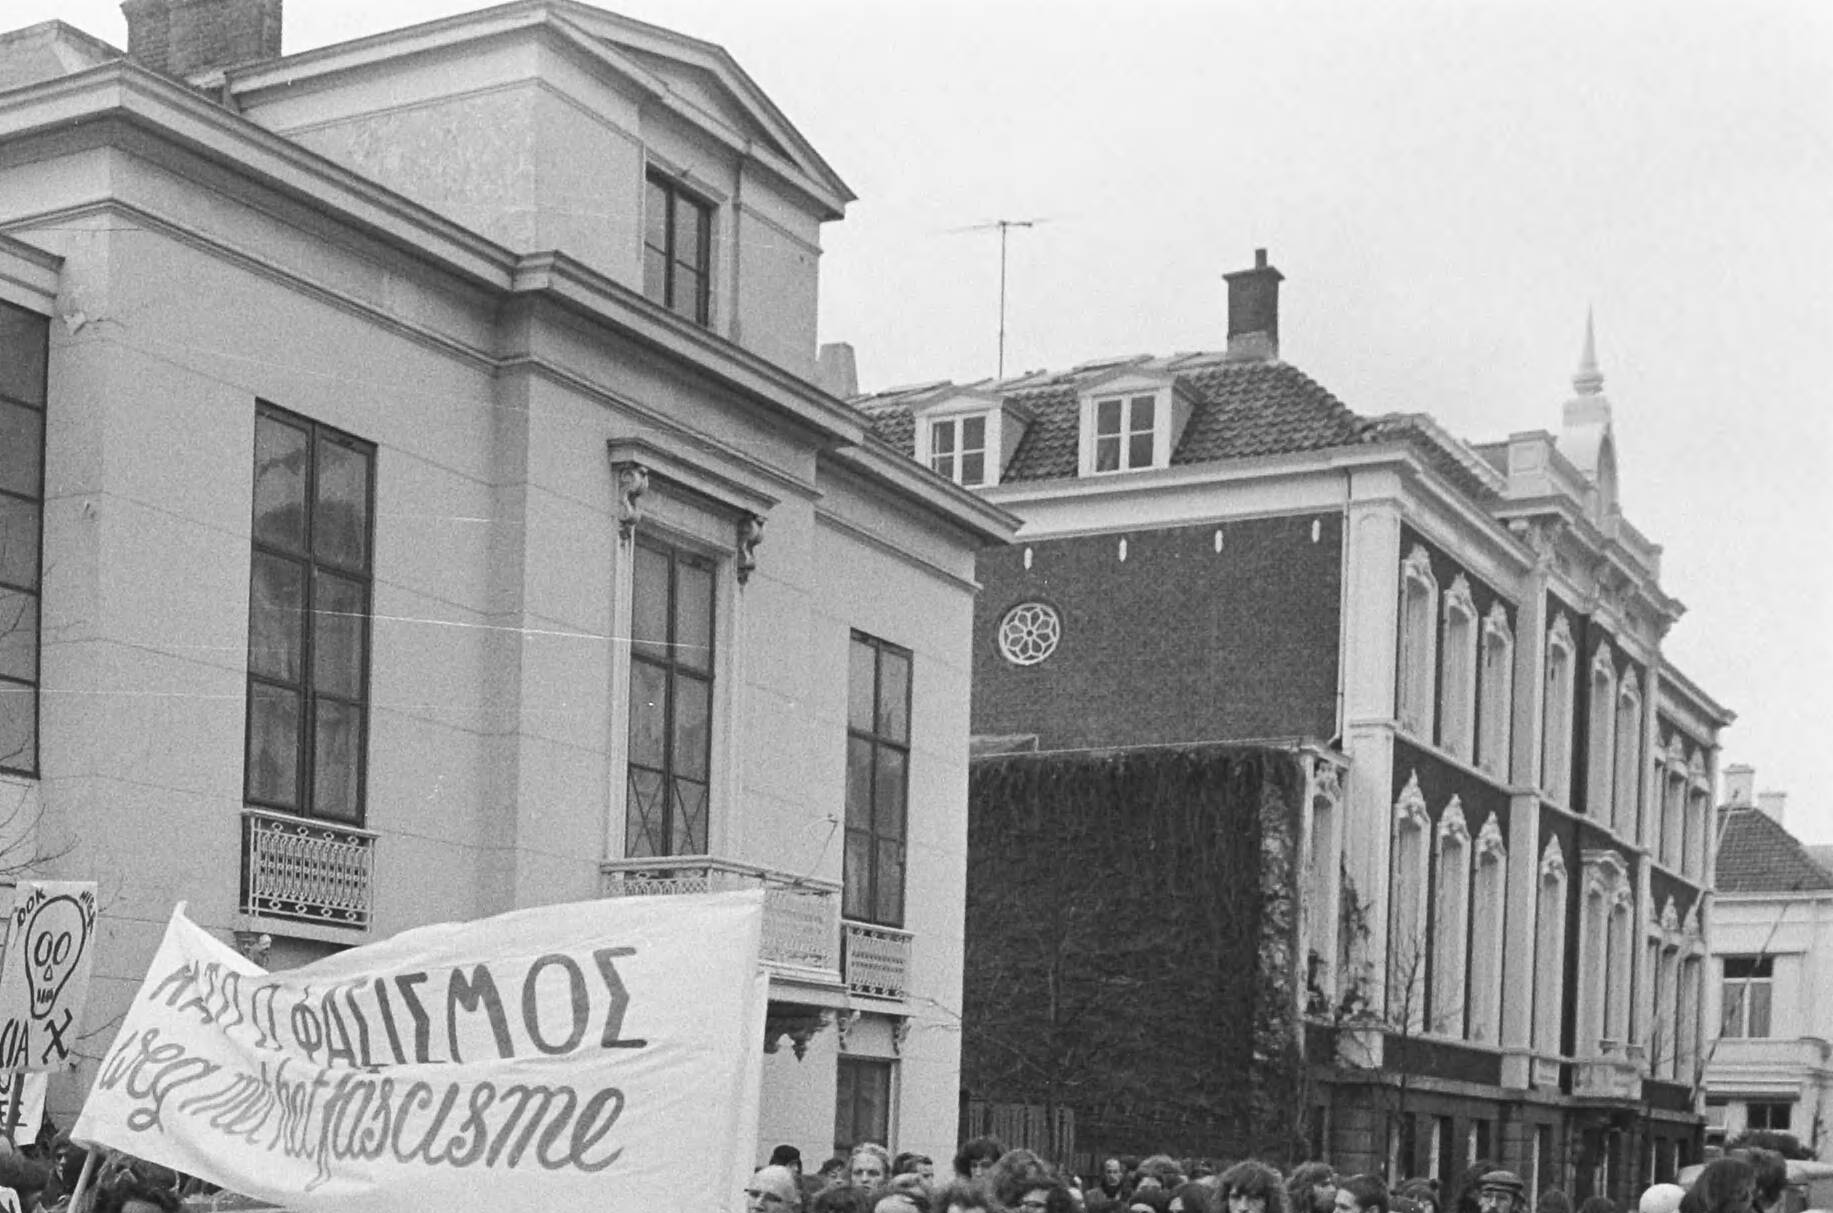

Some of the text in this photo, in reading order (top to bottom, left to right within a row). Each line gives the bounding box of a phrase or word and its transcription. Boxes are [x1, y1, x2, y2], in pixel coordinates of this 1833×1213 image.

[17, 889, 46, 927] OOK
[267, 1056, 329, 1159] het
[303, 1072, 626, 1192] fascisme
